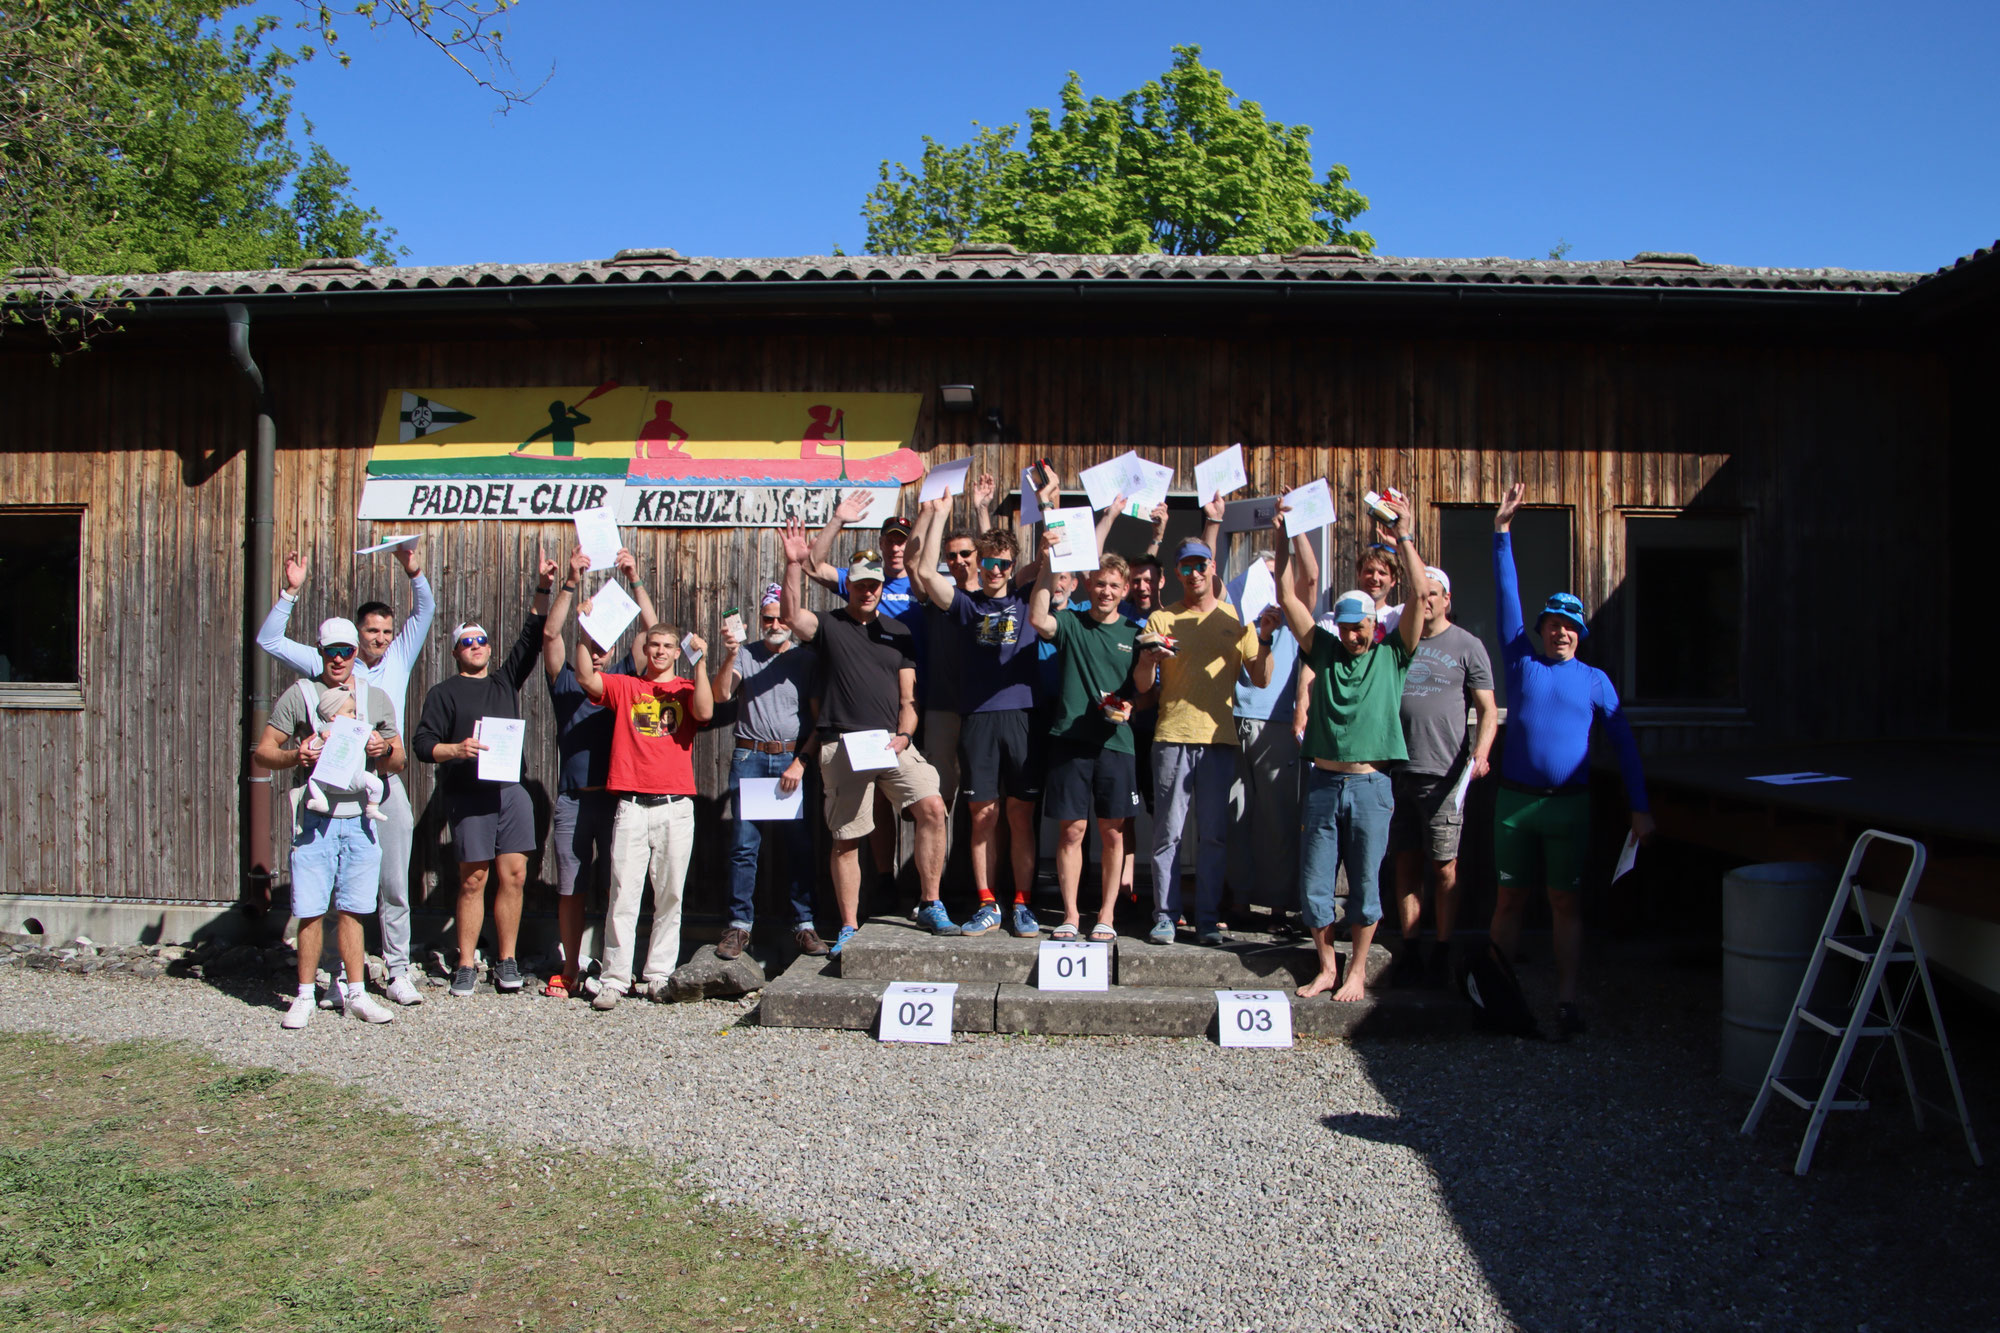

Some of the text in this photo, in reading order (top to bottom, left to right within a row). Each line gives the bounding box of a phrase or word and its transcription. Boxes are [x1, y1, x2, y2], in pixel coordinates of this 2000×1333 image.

[408, 483, 842, 524] PADDEL-CLUB KREUZLNGEN
[1417, 646, 1458, 669] TAILOR
[1056, 956, 1087, 978] 01
[898, 1001, 934, 1027] 02
[1236, 1008, 1273, 1032] 03
